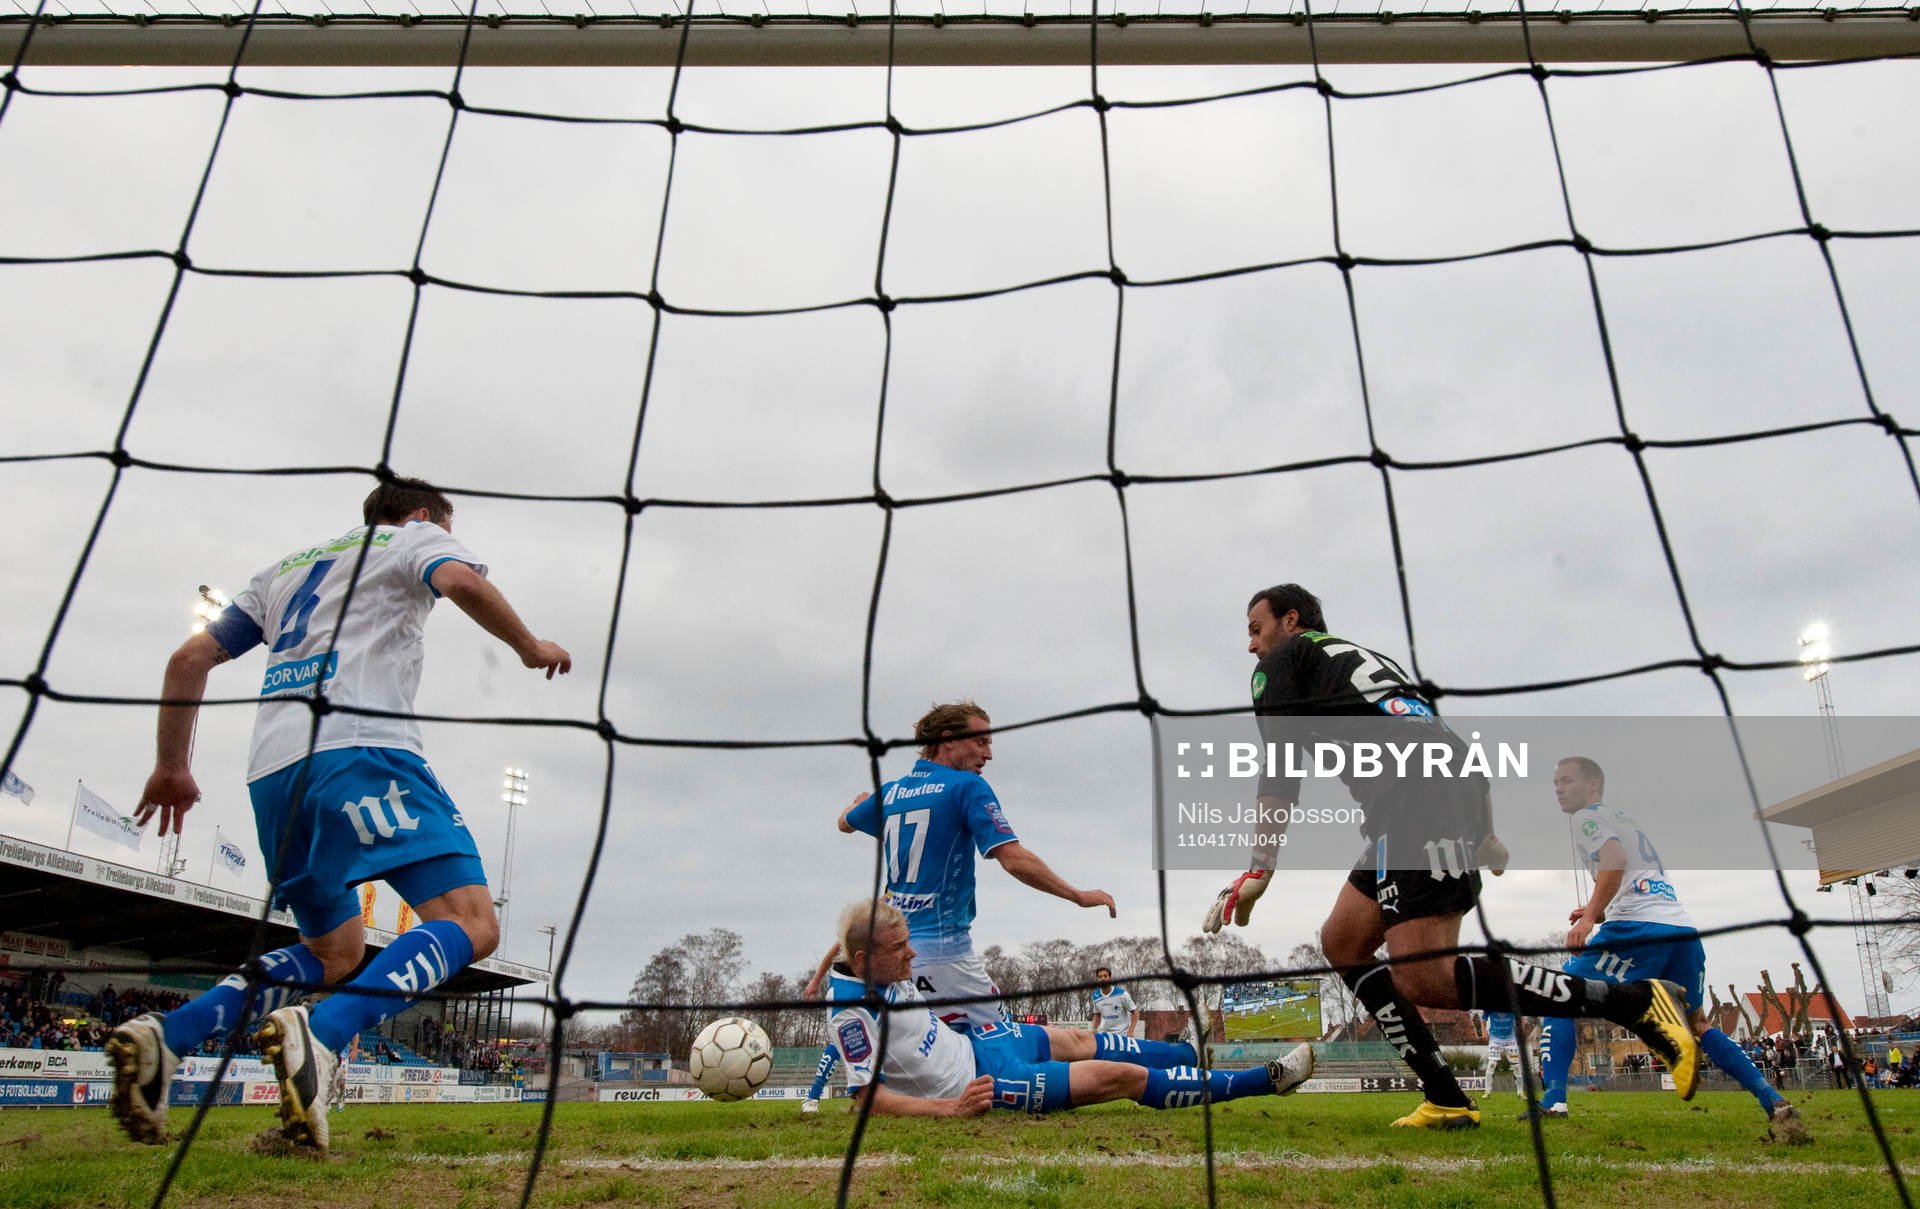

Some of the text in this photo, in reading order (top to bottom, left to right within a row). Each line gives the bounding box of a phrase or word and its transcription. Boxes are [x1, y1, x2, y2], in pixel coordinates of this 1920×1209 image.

[897, 783, 946, 800] Roxtec
[883, 808, 931, 883] 17
[0, 841, 84, 874] Trelleborgs Allehanda
[105, 867, 175, 895] Trelleborgs Allehanda
[193, 888, 251, 913] Trelleborgs Allehanda
[1510, 959, 1573, 1003] SITA
[48, 1057, 68, 1067] BCA
[88, 1085, 114, 1100] STRY
[253, 1085, 280, 1099] DH
[615, 1088, 660, 1100] reusch
